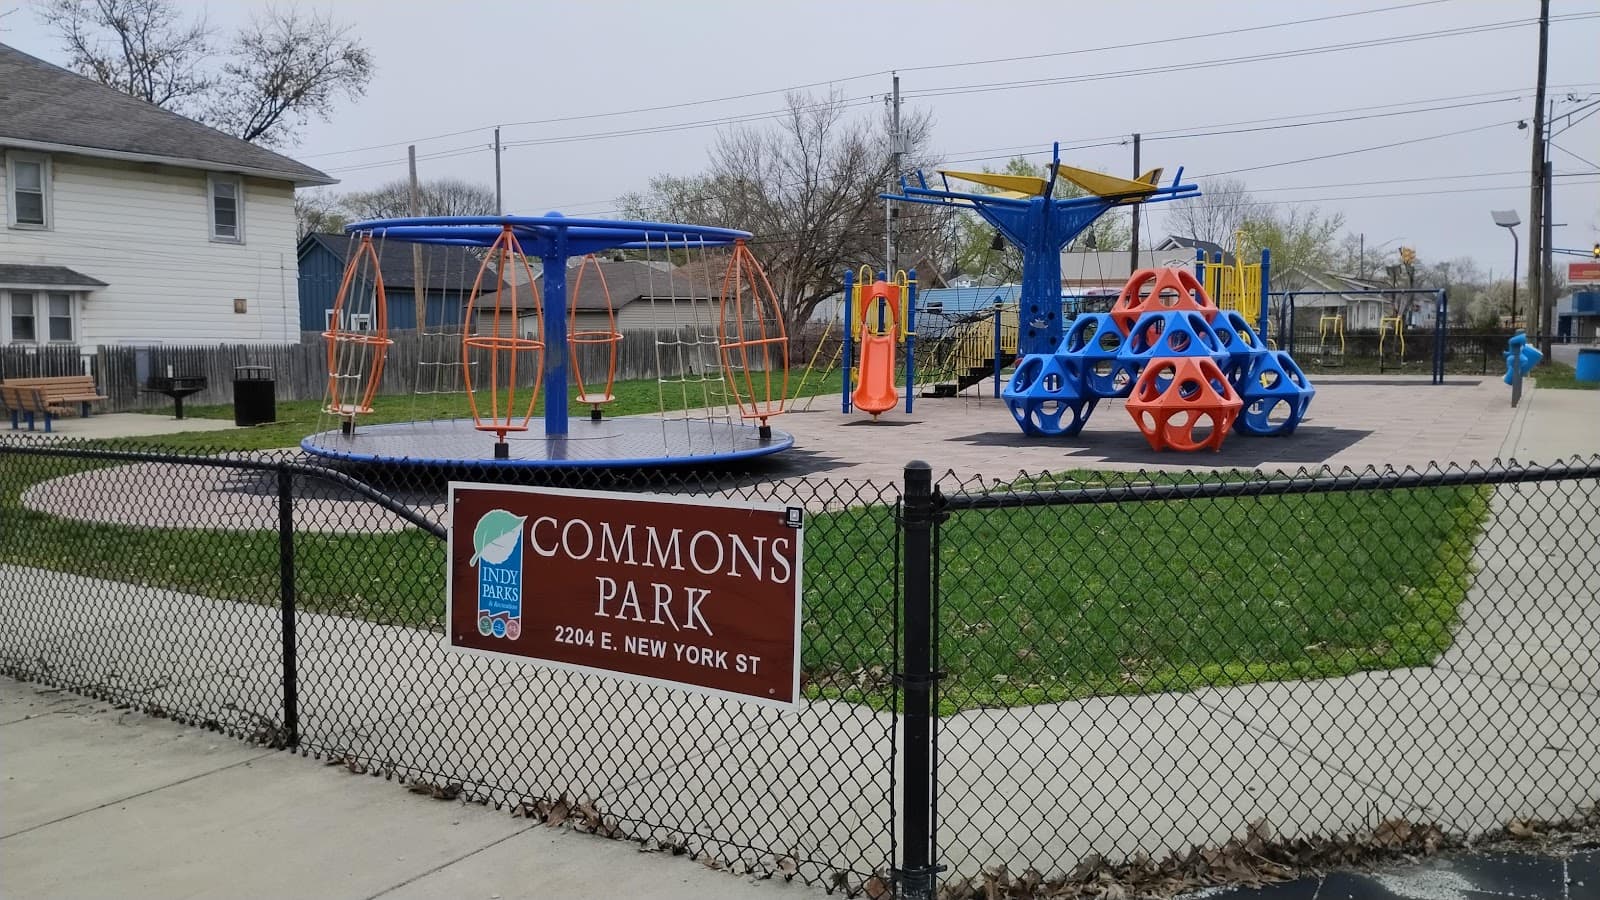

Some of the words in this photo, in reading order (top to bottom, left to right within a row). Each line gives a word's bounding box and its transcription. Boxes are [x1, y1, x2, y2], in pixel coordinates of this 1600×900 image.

[529, 516, 792, 584] COMMONS
[482, 567, 519, 585] INDY
[482, 583, 519, 602] PARKS
[594, 576, 713, 636] PARK
[555, 625, 595, 647] 2204
[601, 636, 618, 652] E.
[625, 635, 667, 659] NEW
[673, 642, 728, 670] YORK
[735, 653, 761, 675] ST
